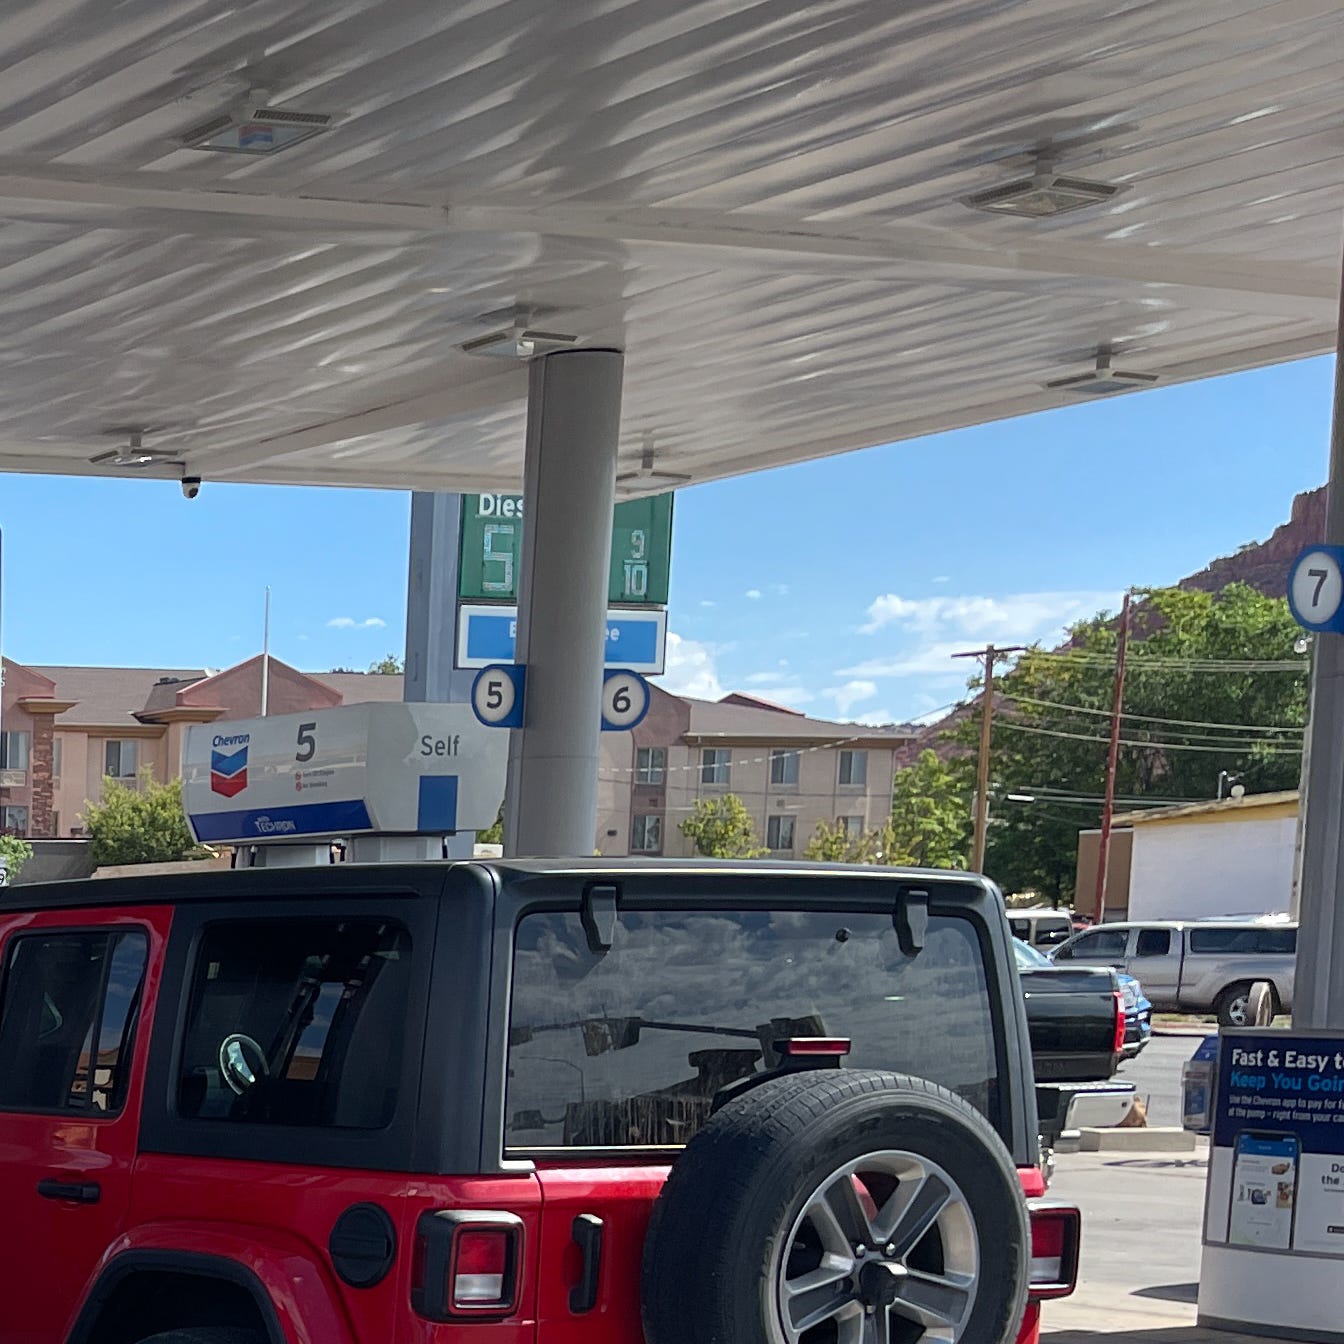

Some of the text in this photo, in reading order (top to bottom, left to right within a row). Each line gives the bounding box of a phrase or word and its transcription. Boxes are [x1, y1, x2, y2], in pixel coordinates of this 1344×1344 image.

[631, 530, 645, 559] 9
[624, 563, 648, 596] 10
[1308, 569, 1329, 607] 7
[487, 681, 503, 709] 5
[612, 686, 631, 713] 6
[213, 733, 251, 748] Chevron
[295, 722, 316, 762] 5
[420, 734, 460, 757] Self
[1232, 1049, 1344, 1073] Fast & Easy t
[1231, 1071, 1344, 1092] Keep You Goin
[1322, 1175, 1340, 1186] the
